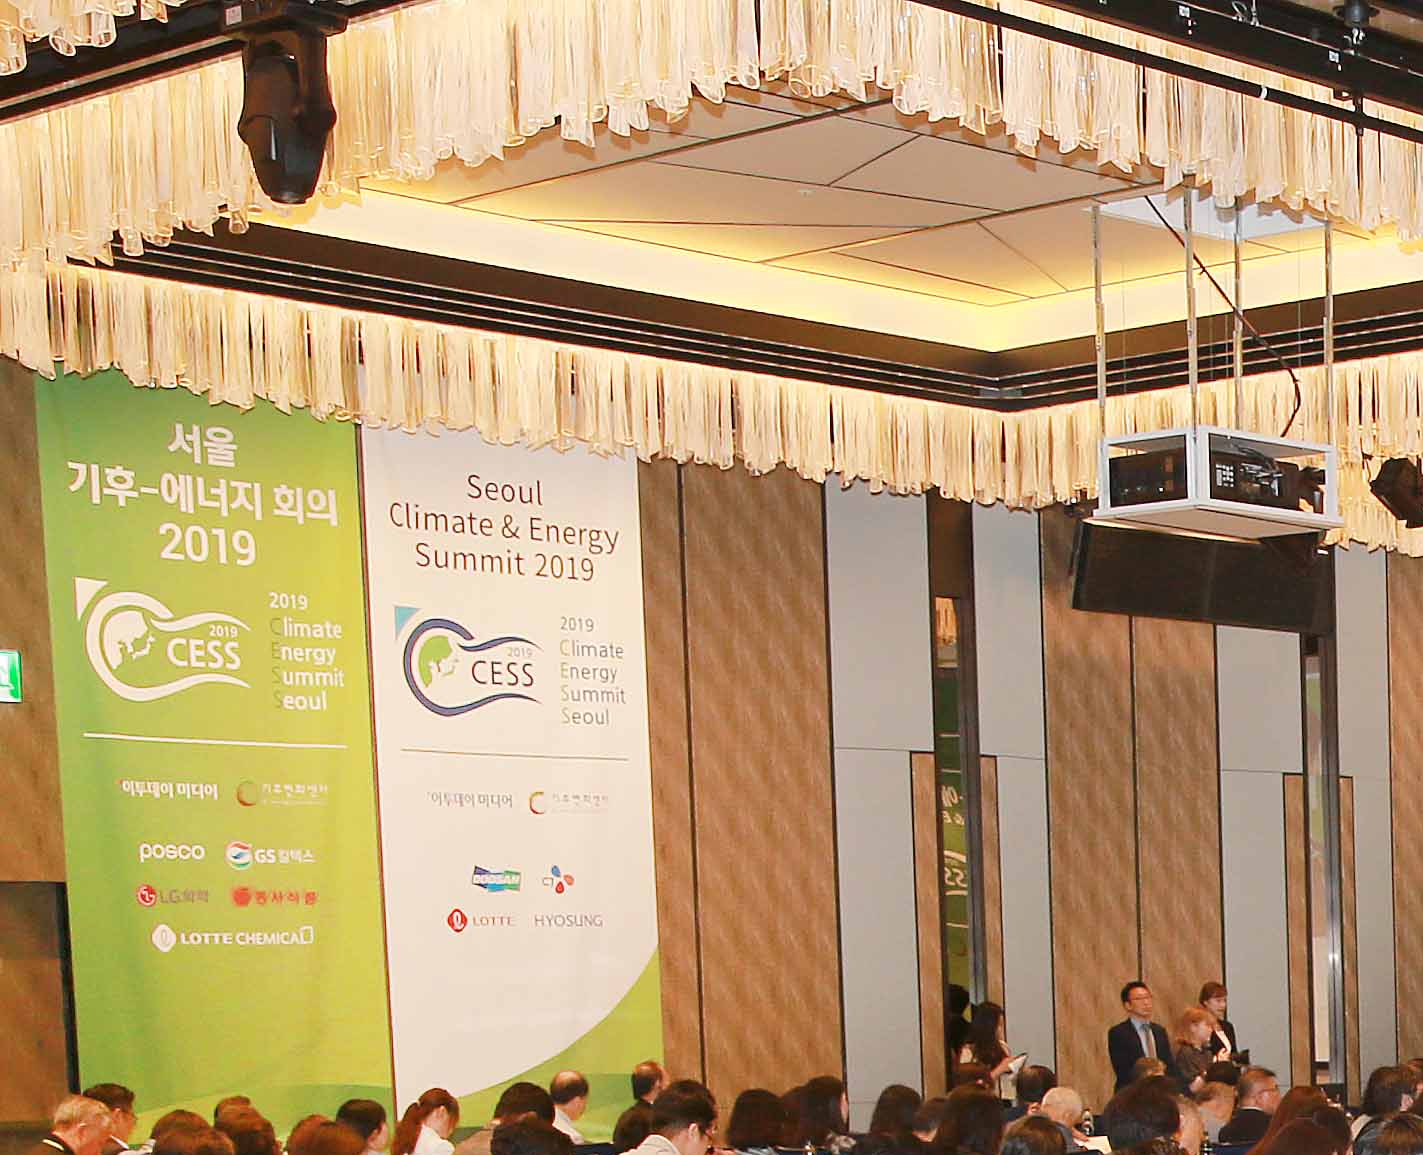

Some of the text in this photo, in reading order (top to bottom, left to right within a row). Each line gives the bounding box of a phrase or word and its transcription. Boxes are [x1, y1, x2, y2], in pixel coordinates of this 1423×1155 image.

[168, 423, 238, 468] 서울
[67, 461, 339, 527] 기후-에너지 회의
[466, 474, 543, 506] Seoul
[389, 501, 620, 555] Climate & Energy
[159, 522, 257, 567] 2019
[415, 541, 595, 582] Summit 2019
[268, 591, 309, 611] 2019
[209, 624, 239, 638] 2019
[270, 616, 343, 640] Climate
[560, 616, 594, 632] 2019
[166, 637, 242, 671] CESS
[271, 641, 337, 666] Energy
[507, 647, 533, 658] 2019
[559, 639, 625, 660] Climate
[271, 666, 346, 688] Summit
[471, 659, 535, 687] CESS
[559, 661, 618, 684] Energy
[273, 688, 328, 711] Seoul
[560, 684, 627, 705] Summit
[560, 706, 610, 726] Seoul
[473, 915, 515, 928] LOTTE
[534, 914, 604, 928] HYOSUNG
[180, 931, 234, 946] LOTTE
